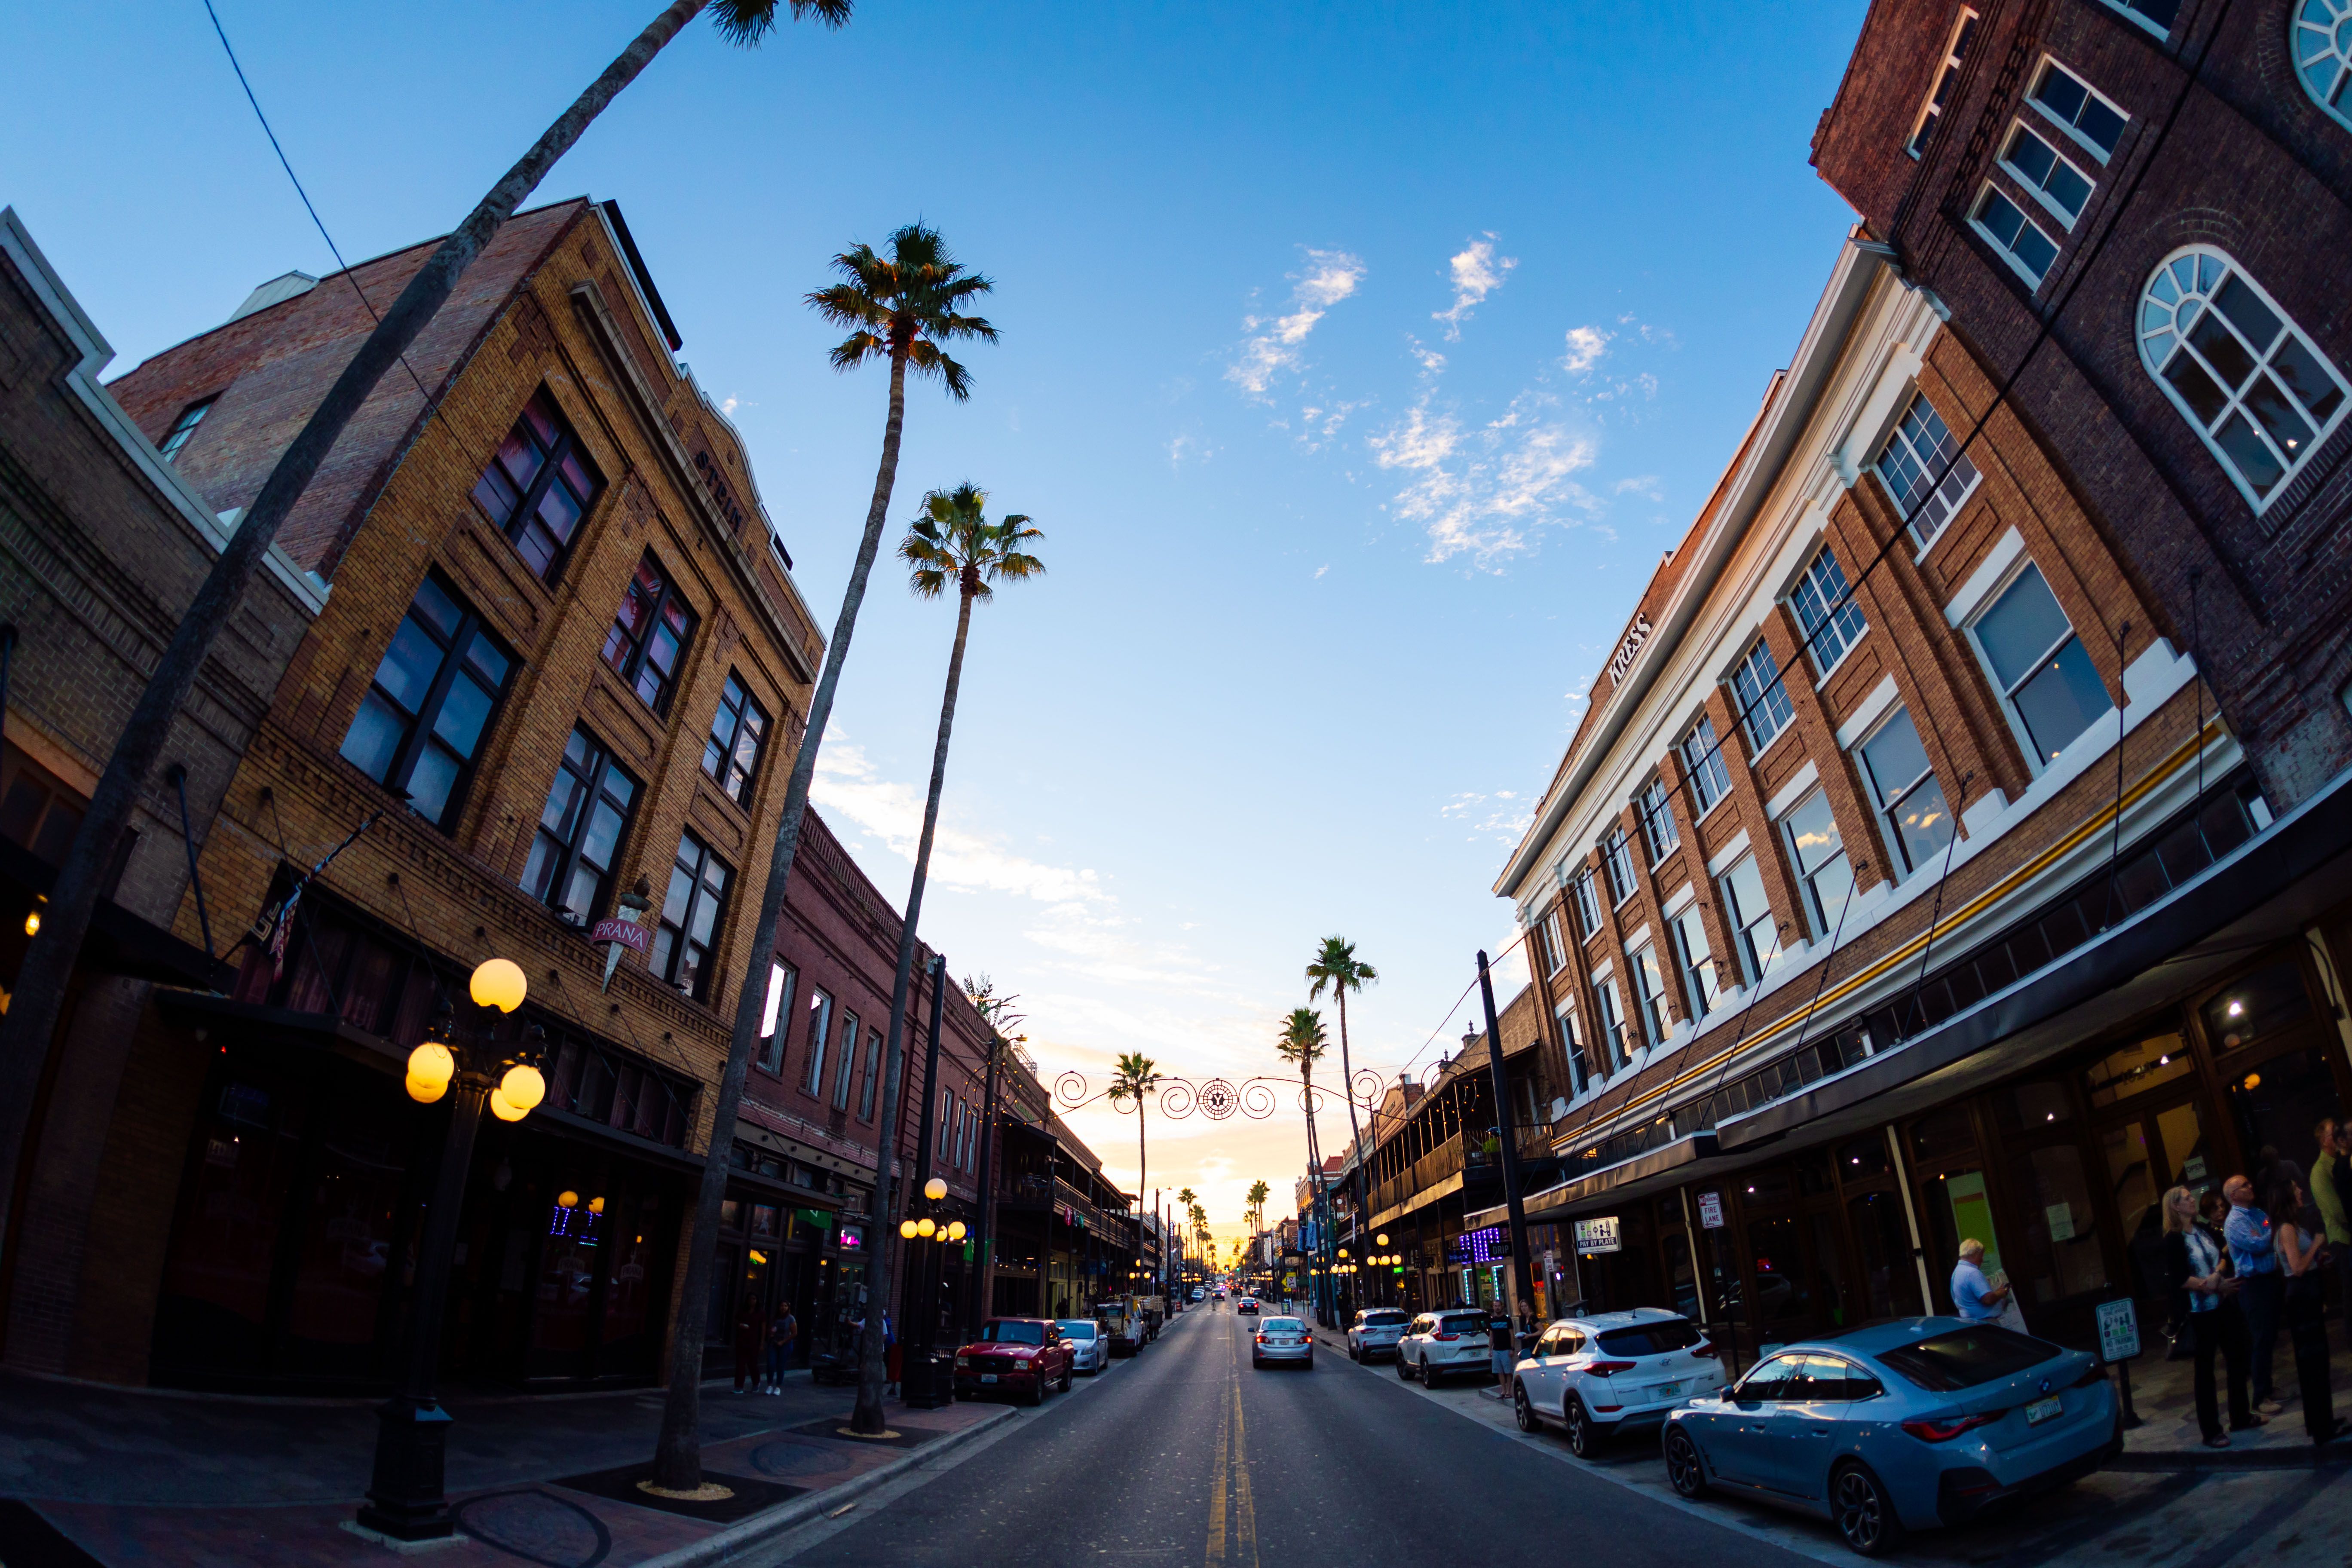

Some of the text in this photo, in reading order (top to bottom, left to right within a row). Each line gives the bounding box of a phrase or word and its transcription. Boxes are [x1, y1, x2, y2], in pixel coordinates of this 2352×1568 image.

[1607, 612, 1653, 688] KRESS
[595, 922, 643, 948] PRANA
[2187, 1162, 2204, 1173] OPEN
[1704, 1206, 1717, 1214] FIRE
[1705, 1215, 1720, 1223] LANE
[1492, 1245, 1509, 1255] DRIP
